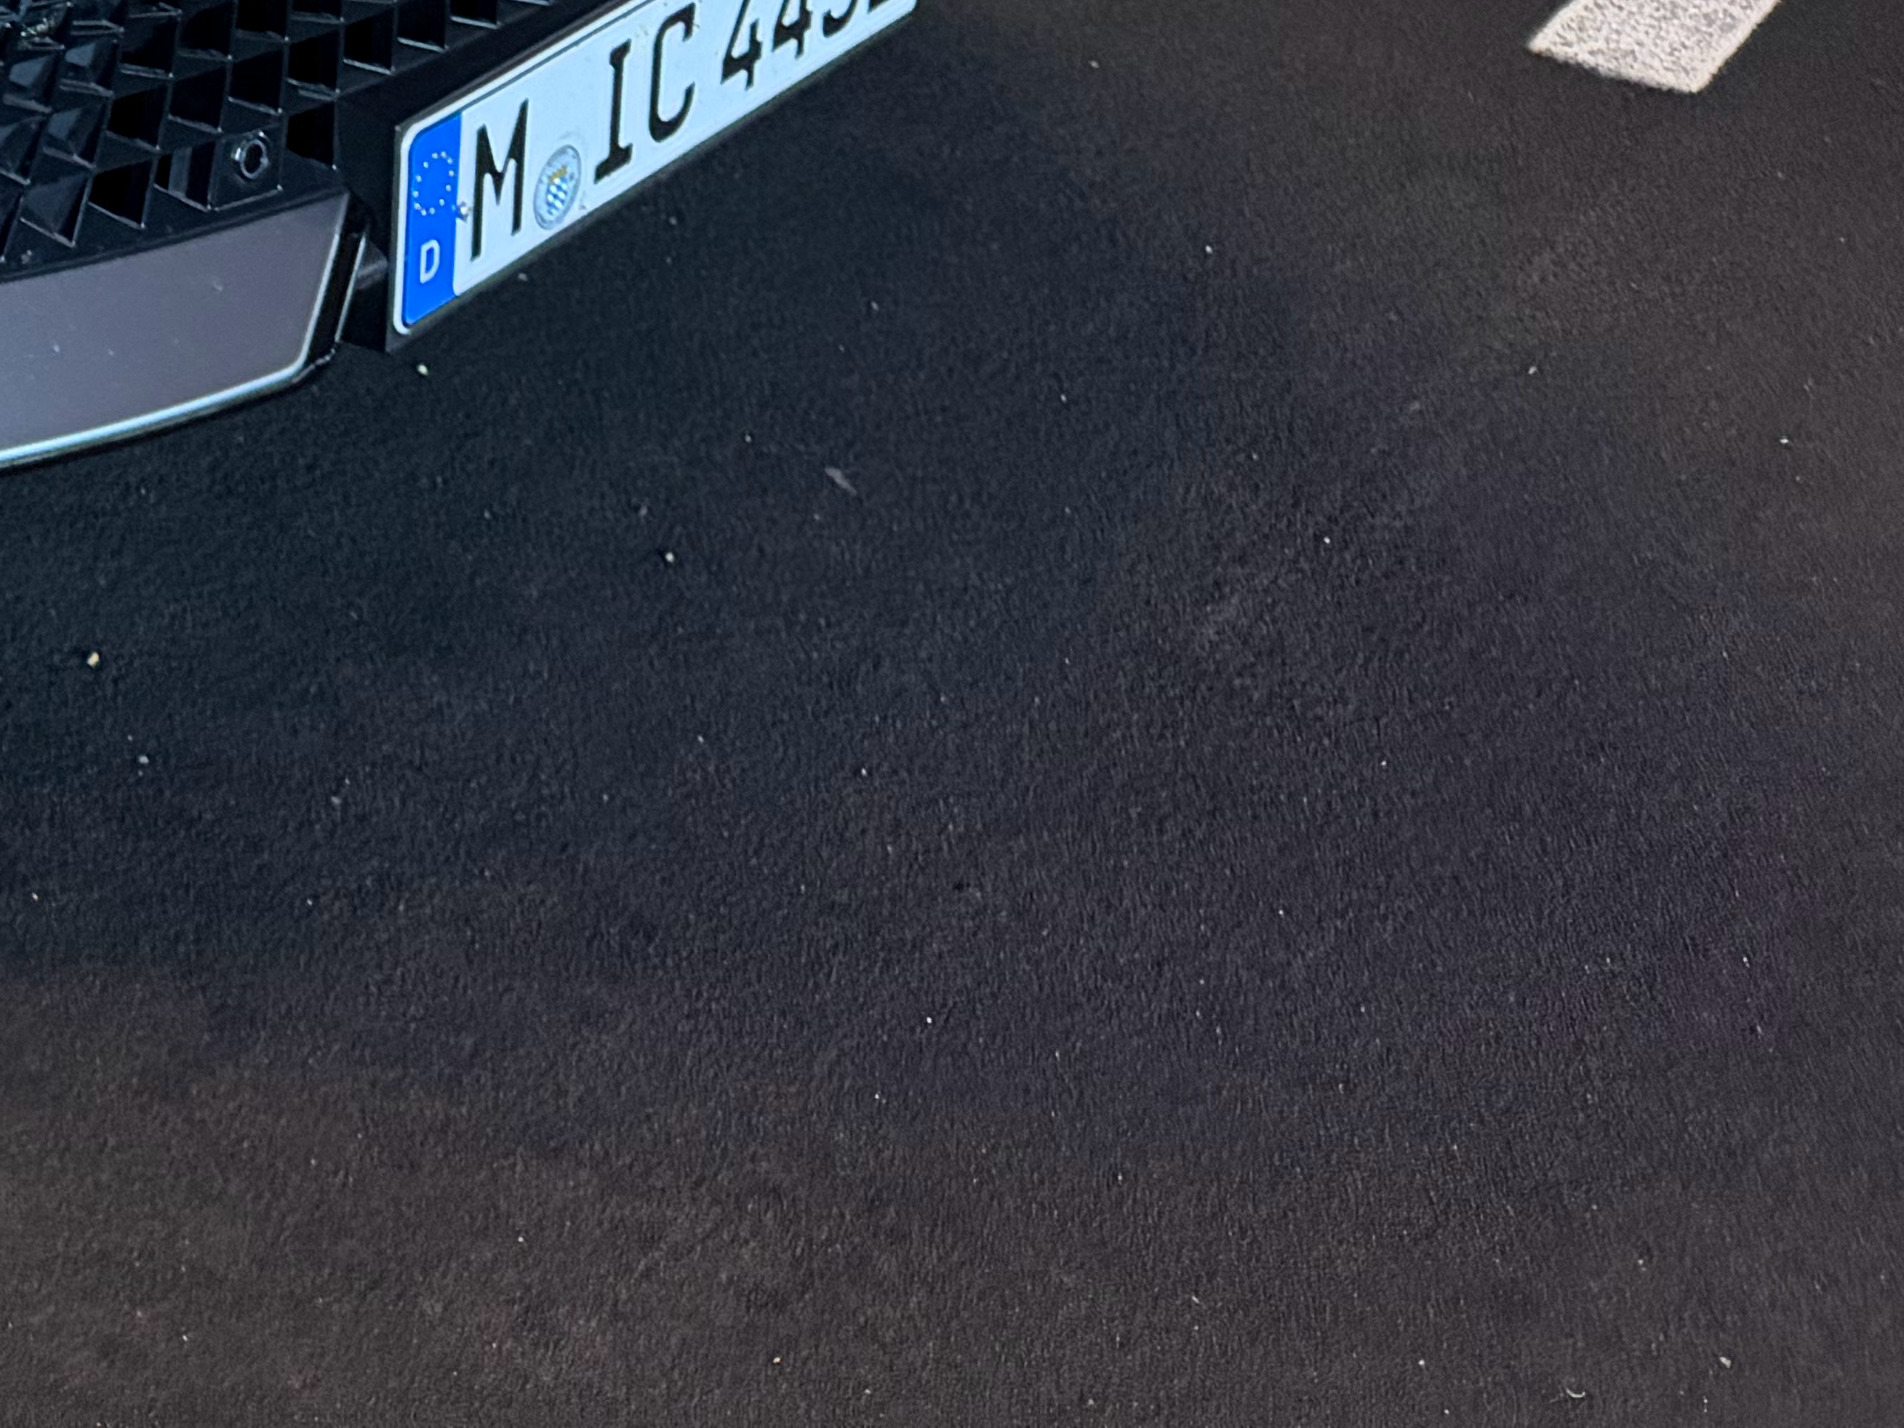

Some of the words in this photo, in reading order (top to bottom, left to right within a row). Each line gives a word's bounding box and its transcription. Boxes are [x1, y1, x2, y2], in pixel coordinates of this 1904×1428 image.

[469, 98, 530, 262] M
[594, 1, 696, 185] IC
[419, 239, 440, 283] D
